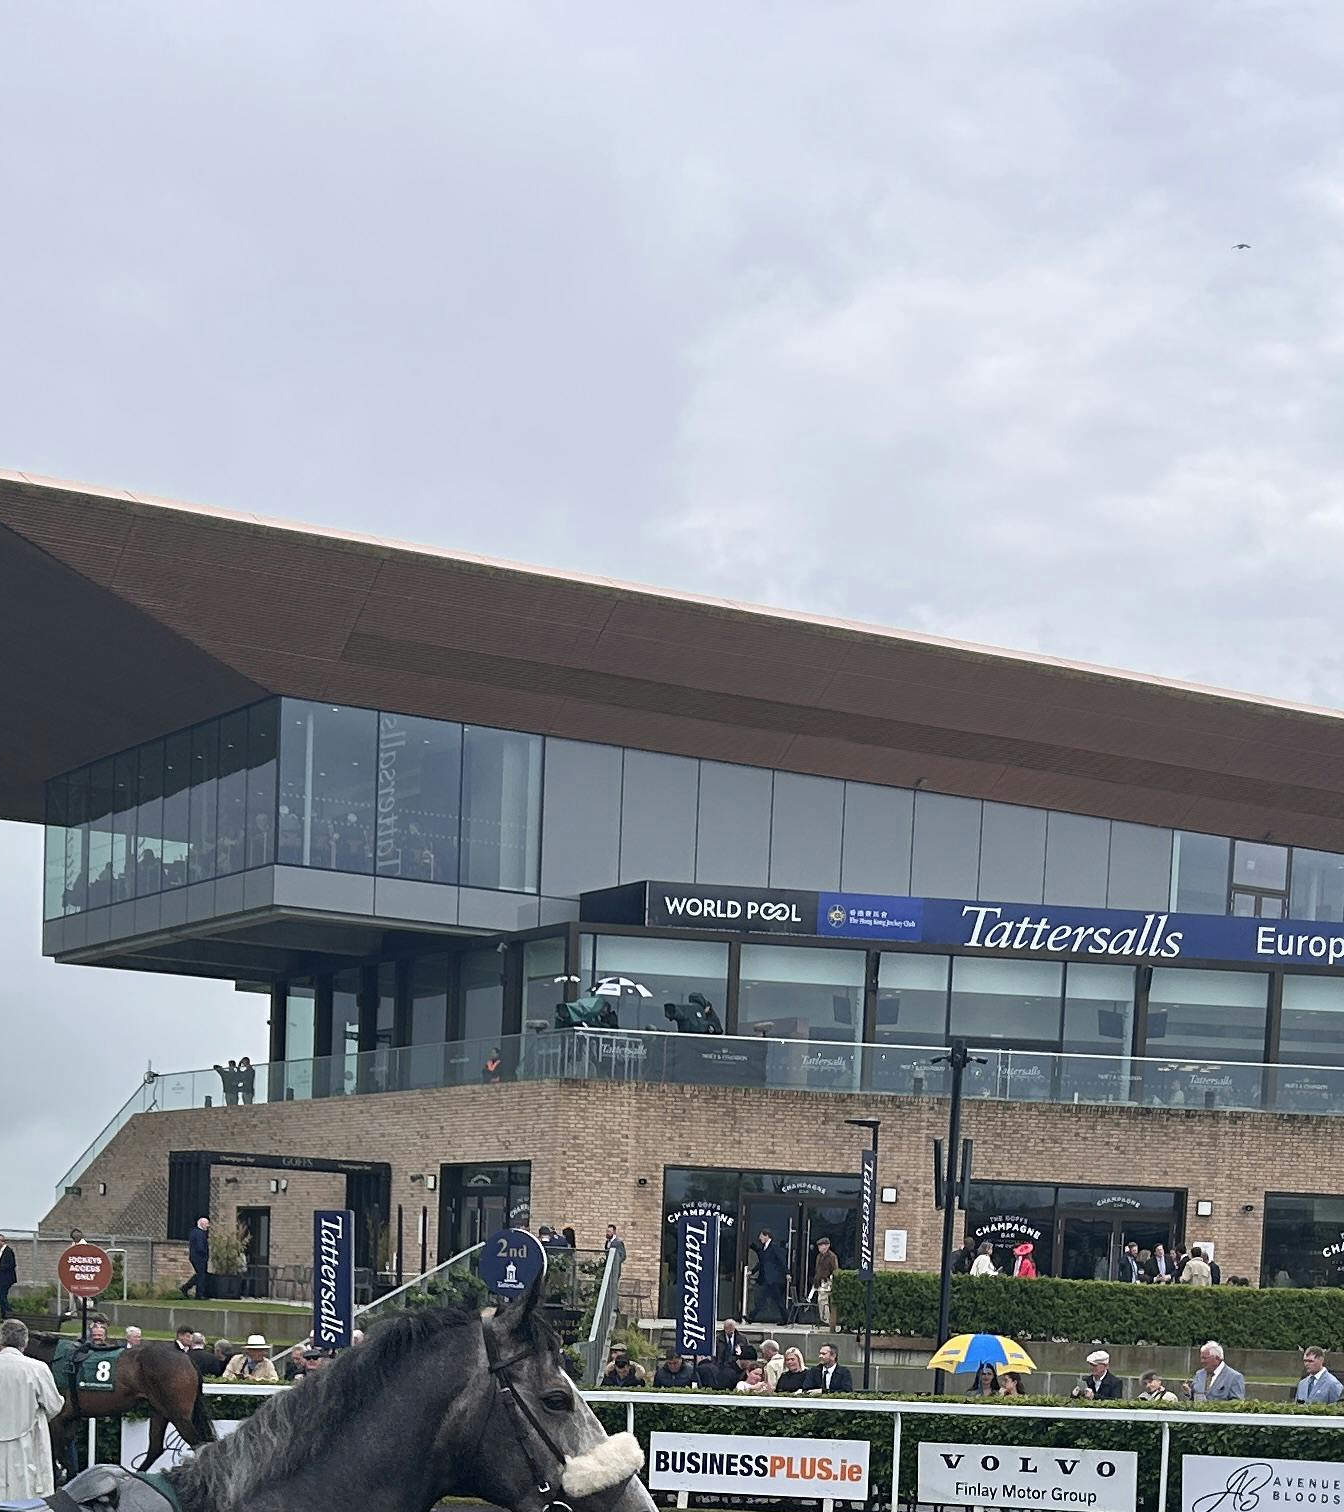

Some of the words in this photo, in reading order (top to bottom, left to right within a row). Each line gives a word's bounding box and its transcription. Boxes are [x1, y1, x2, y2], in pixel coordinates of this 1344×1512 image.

[664, 896, 742, 919] WORLD
[747, 901, 802, 922] POOL
[961, 905, 1184, 958] Tattersalls
[861, 1159, 874, 1271] Tattersalls
[975, 1222, 1042, 1240] CHAMPAGNE
[67, 1256, 103, 1264] JOCKEYS
[496, 1238, 528, 1258] 2nd
[69, 1264, 101, 1272] ACCESS
[320, 1215, 344, 1343] Tattersalls
[682, 1220, 708, 1351] Tattersalls
[96, 1360, 111, 1382] 8
[655, 1450, 863, 1482] BUSINESSPLUS.ie
[940, 1453, 1116, 1478] VOLVO
[955, 1481, 998, 1500] Finlay
[1002, 1484, 1047, 1500] Motor
[1051, 1487, 1097, 1506] Group
[1272, 1476, 1341, 1490] AVENUE
